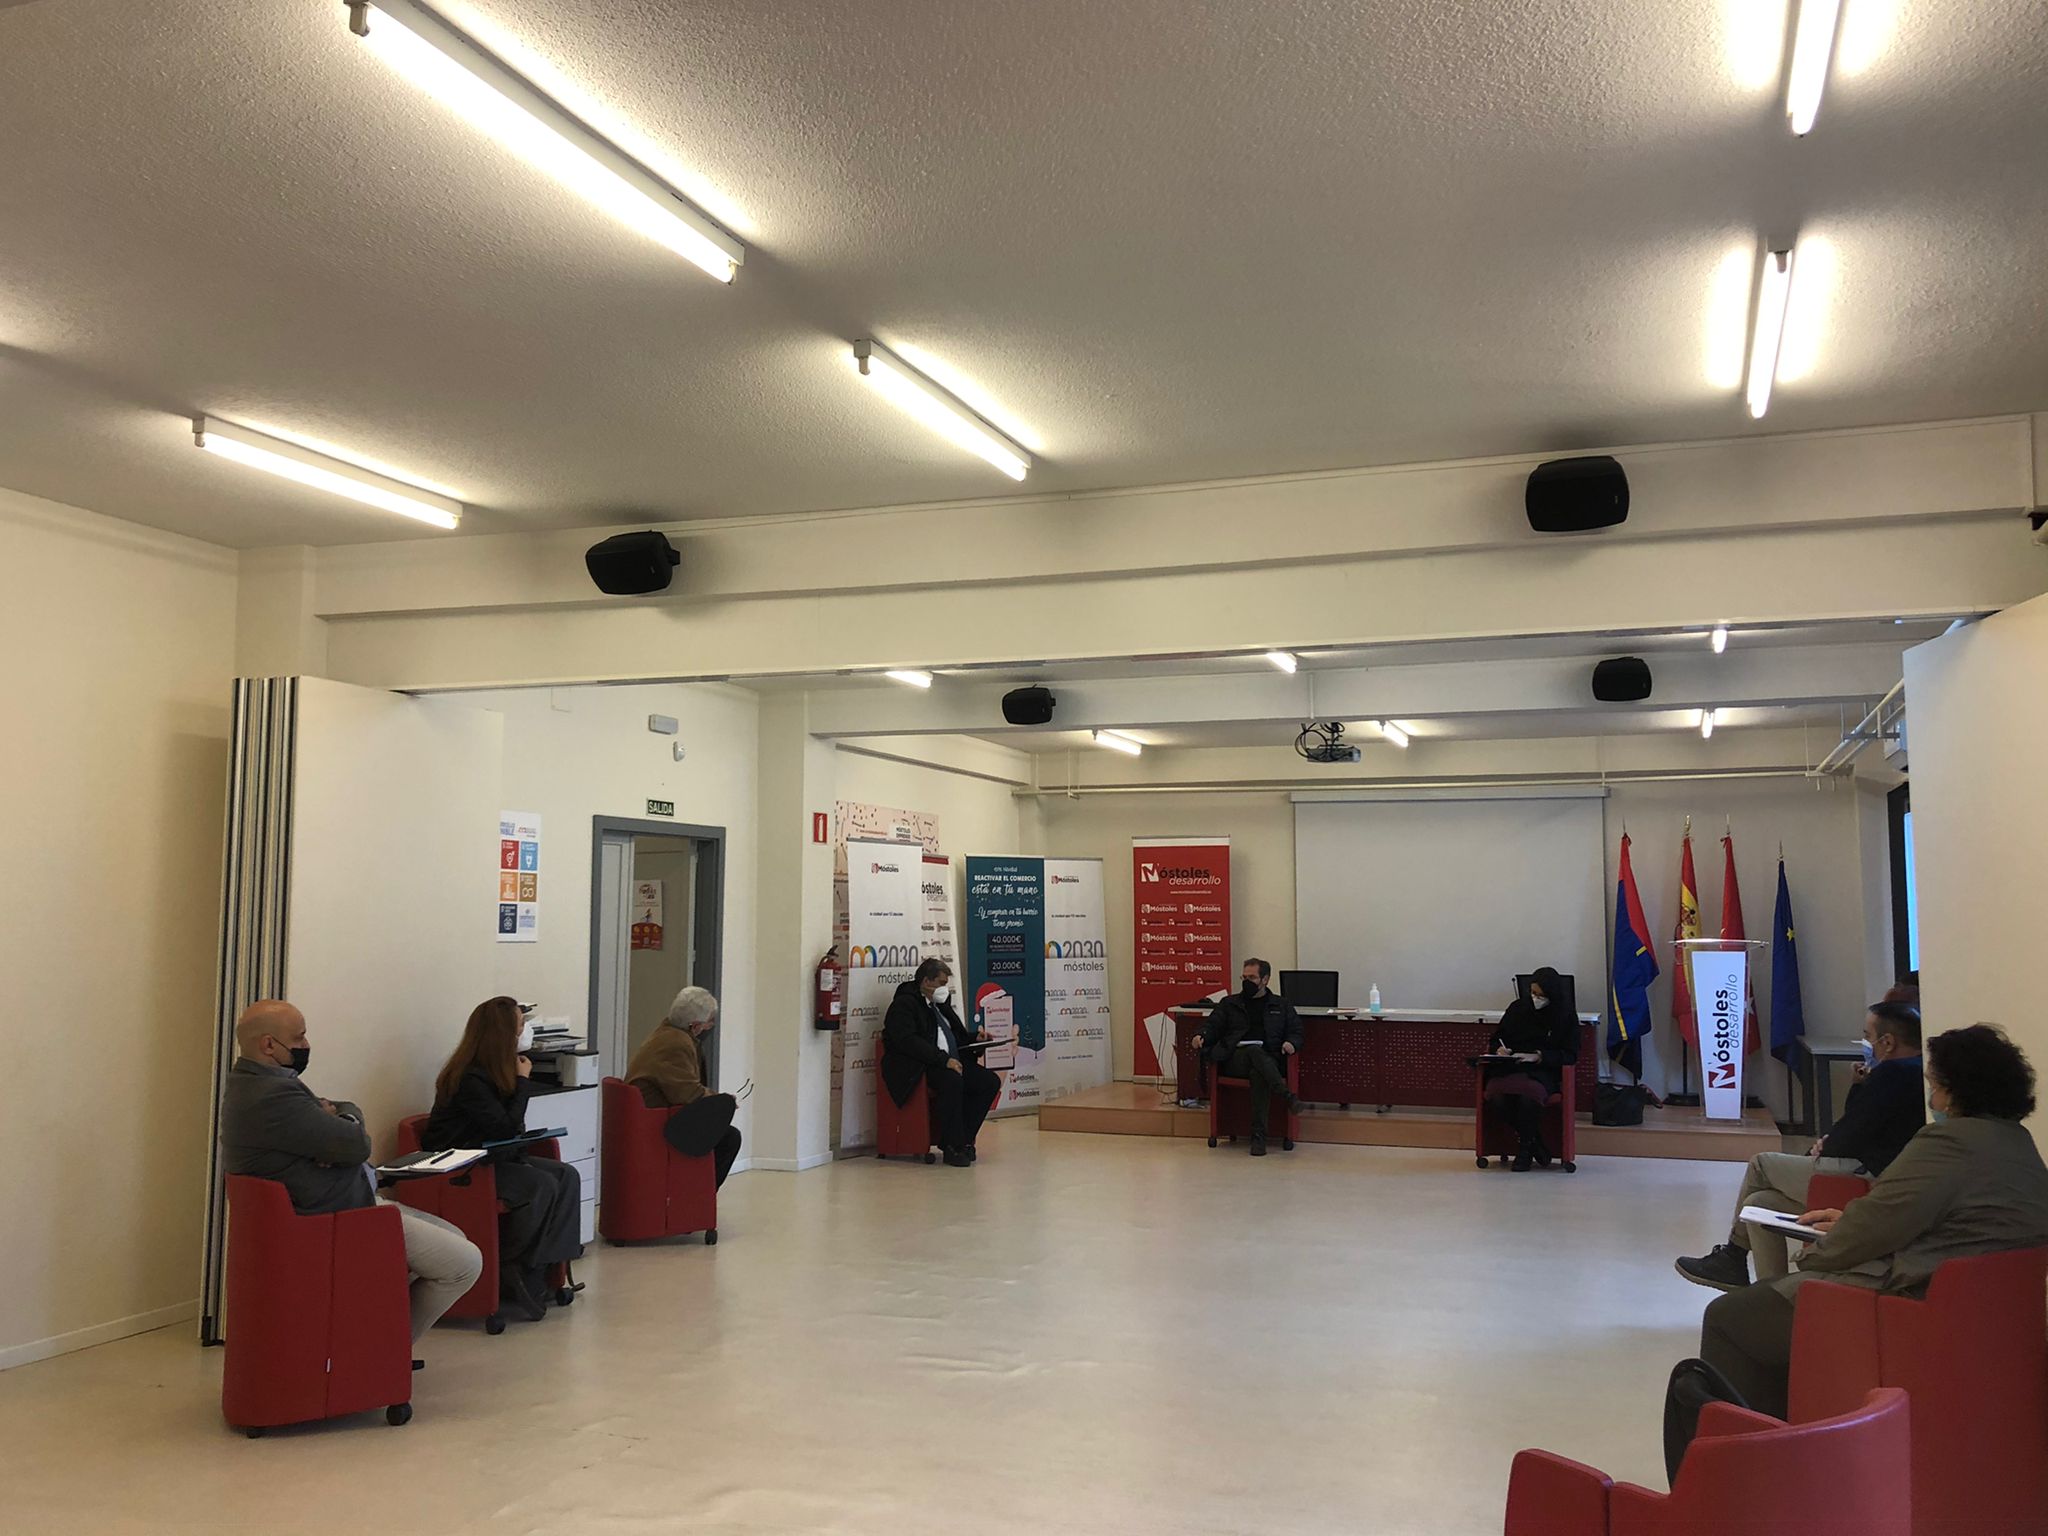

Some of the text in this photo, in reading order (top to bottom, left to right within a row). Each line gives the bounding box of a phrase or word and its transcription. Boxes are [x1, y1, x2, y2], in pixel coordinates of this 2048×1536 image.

[648, 801, 673, 815] SALIDA
[1169, 876, 1222, 886] desarrollo
[922, 881, 944, 895] óstoles
[992, 886, 1002, 895] en
[1017, 886, 1039, 895] mano
[991, 935, 1022, 944] 40.000€
[992, 961, 1022, 970] 20.000€
[1063, 961, 1105, 972] móstoles
[877, 971, 914, 984] móstole
[1725, 974, 1740, 1049] desarrollo
